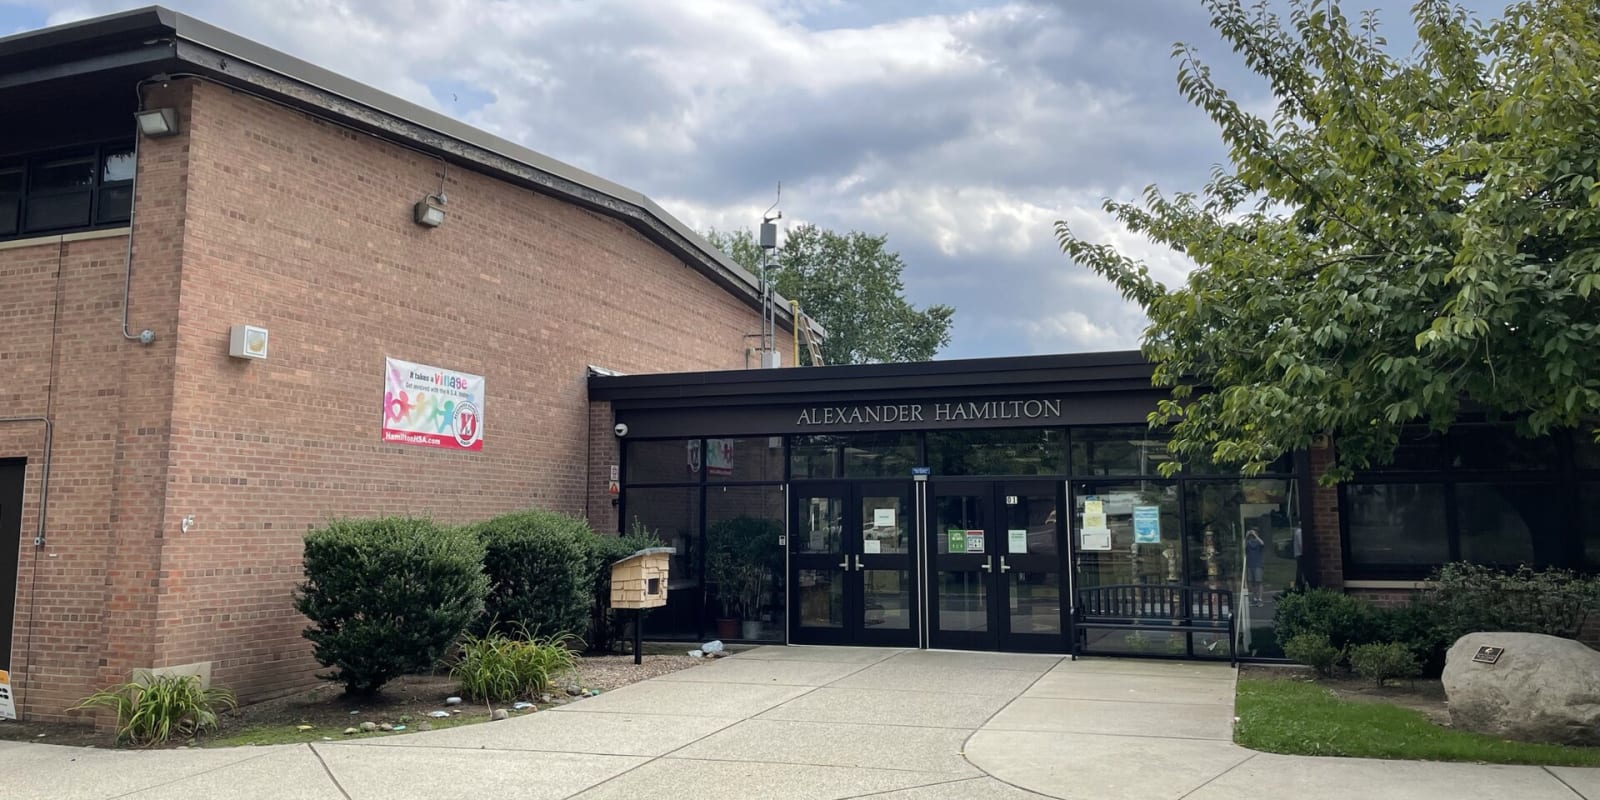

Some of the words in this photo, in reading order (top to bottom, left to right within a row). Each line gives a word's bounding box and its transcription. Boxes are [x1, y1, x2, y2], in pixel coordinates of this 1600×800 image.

[415, 373, 430, 382] takes
[796, 404, 924, 425] ALEXANDER
[935, 399, 1062, 421] HAMILTON
[1007, 496, 1017, 504] 01
